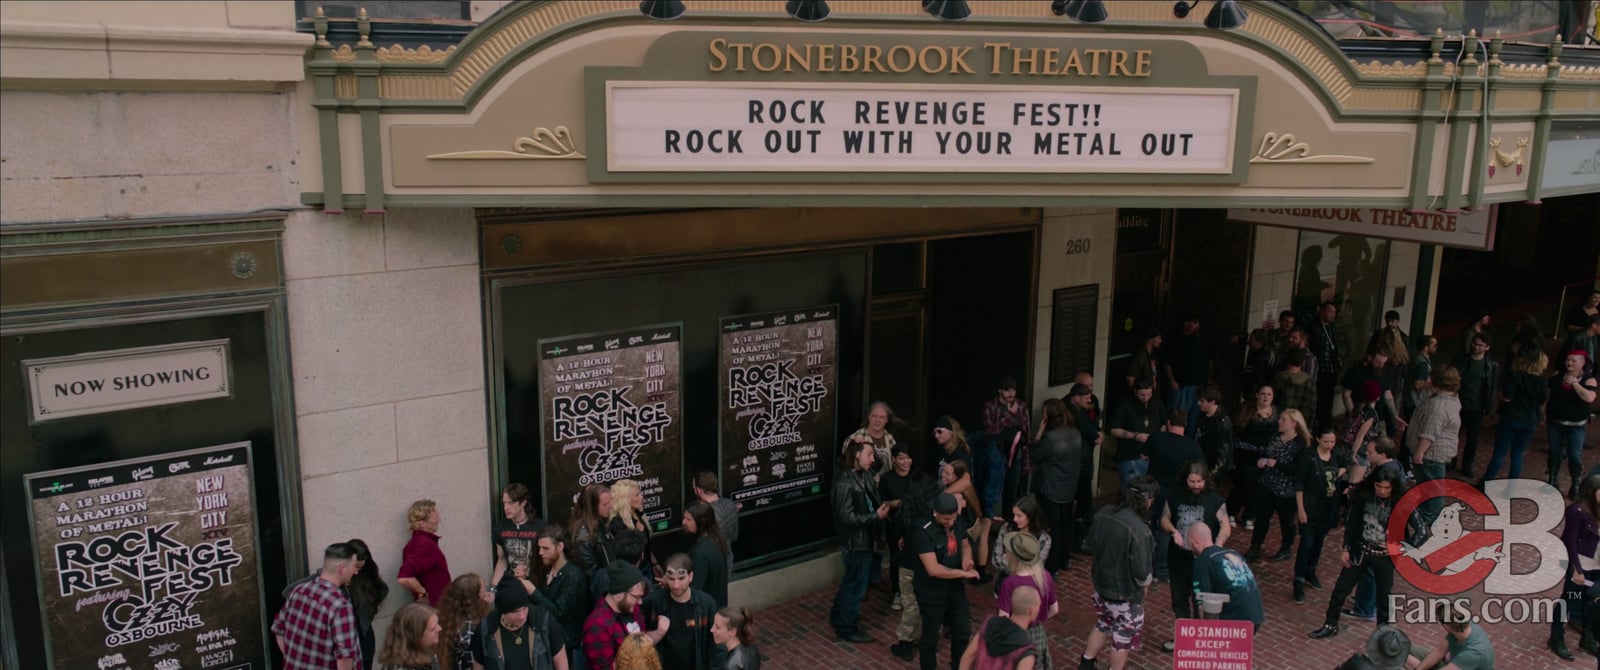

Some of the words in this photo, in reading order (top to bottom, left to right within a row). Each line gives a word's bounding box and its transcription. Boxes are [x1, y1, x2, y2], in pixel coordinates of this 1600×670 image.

[708, 38, 975, 75] STONEBROOK
[983, 43, 1152, 78] THEATRE
[748, 100, 825, 124] ROCK
[854, 101, 986, 125] REVENGE
[1013, 102, 1102, 126] FEST!!
[665, 129, 744, 154] ROCK
[765, 130, 821, 154] OUT
[844, 131, 913, 154] WITH
[936, 131, 1012, 155] YOUR
[1034, 132, 1121, 156] METAL
[1141, 133, 1194, 157] OUT
[1370, 209, 1457, 232] THEATRE
[1066, 238, 1091, 255] 260
[755, 332, 779, 342] HOUR
[807, 327, 823, 339] NEW
[646, 350, 664, 363] NEW
[731, 341, 781, 355] MARATHON
[556, 363, 565, 372] A
[583, 356, 611, 368] HOUR
[733, 356, 745, 365] OF
[807, 354, 823, 366] CITY
[55, 378, 105, 397] NOW
[112, 366, 211, 391] SHOWING
[555, 367, 613, 382] MARATHON
[645, 365, 666, 379] YORK
[729, 359, 796, 388] ROCK
[557, 385, 571, 394] OF
[574, 379, 613, 391] METAL!
[646, 379, 664, 393] CITY
[729, 375, 826, 408] REVENGE
[553, 385, 634, 420] ROCK
[771, 389, 827, 419] FEST
[554, 402, 670, 441] REVENGE
[605, 420, 670, 450] FEST
[197, 475, 225, 494] NEW
[57, 502, 70, 512] A
[76, 497, 94, 509] 12
[98, 489, 144, 506] HOUR
[196, 494, 228, 511] YORK
[56, 501, 149, 526] MARATHON
[200, 511, 227, 529] CITY
[60, 528, 84, 540] OF
[89, 515, 149, 534] METAL!
[55, 521, 183, 570] ROCK
[56, 538, 240, 597] REVENGE
[143, 559, 242, 601] FEST
[76, 587, 130, 611] featuring
[105, 614, 205, 647] OSBOURNE
[1180, 626, 1196, 637] NO
[1198, 627, 1247, 639] STANDING
[1177, 650, 1217, 659] COMMERCIAL
[1219, 651, 1249, 660] VEHICLES
[1195, 640, 1231, 649] EXCEPT
[1178, 660, 1211, 670] METERED
[1212, 661, 1247, 670] PARKING
